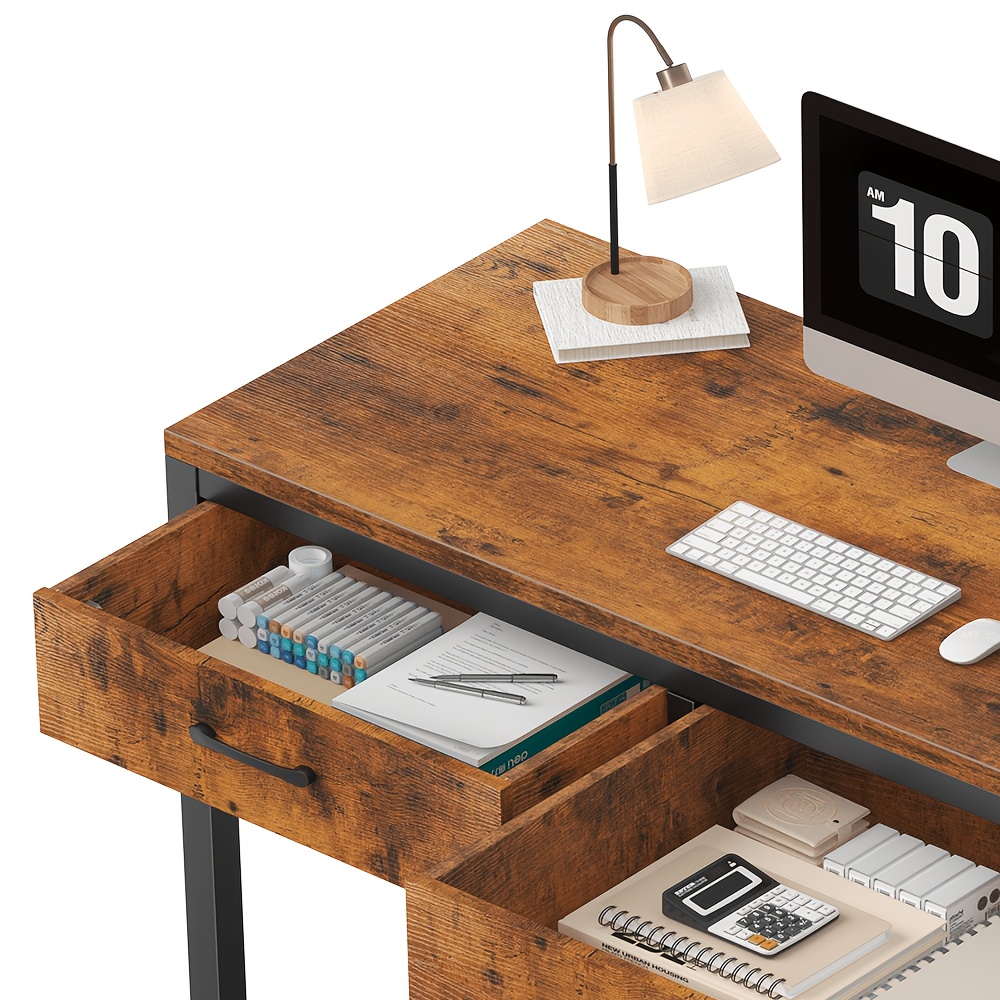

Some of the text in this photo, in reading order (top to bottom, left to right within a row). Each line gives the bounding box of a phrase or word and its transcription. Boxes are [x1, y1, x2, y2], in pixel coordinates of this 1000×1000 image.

[867, 186, 885, 202] AM
[871, 198, 980, 317] 10
[507, 750, 528, 770] deli
[602, 943, 620, 954] NEW
[622, 951, 650, 967] URBAN
[651, 964, 689, 983] HOUSING
